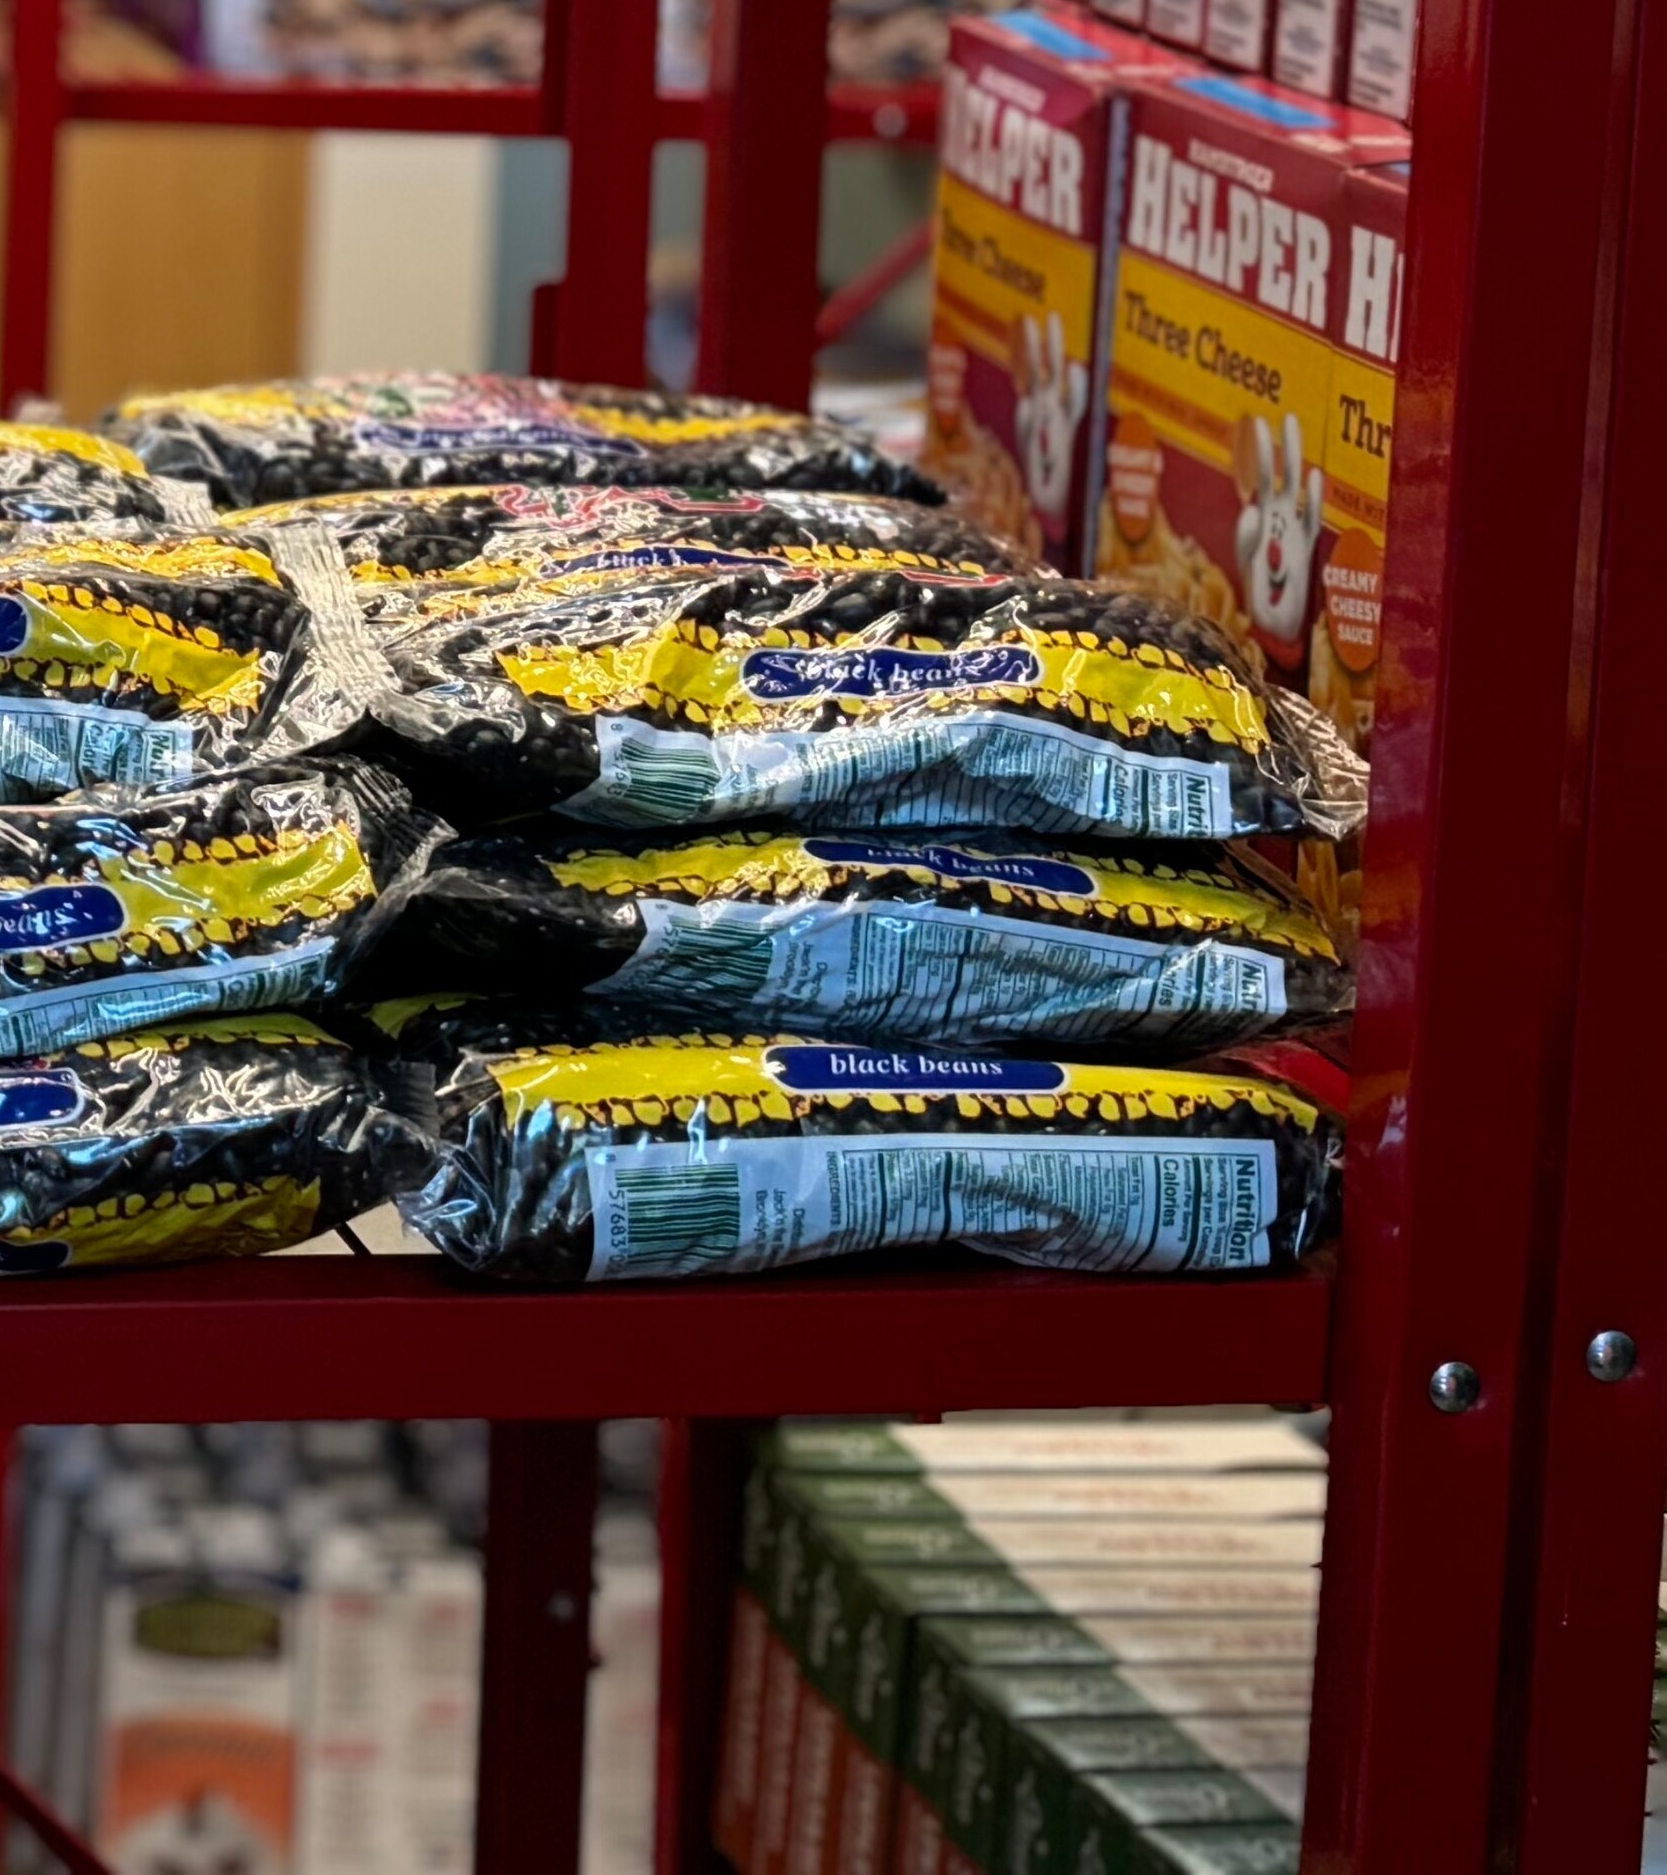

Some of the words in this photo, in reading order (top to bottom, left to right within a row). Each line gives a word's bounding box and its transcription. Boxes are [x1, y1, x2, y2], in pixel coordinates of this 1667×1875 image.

[942, 62, 1084, 237] HELPER
[1128, 133, 1330, 330] HELPER
[1124, 289, 1191, 360] Three
[1193, 328, 1282, 405] Cheese
[1339, 393, 1392, 459] Thr
[1323, 565, 1378, 594] CREAMY
[1331, 596, 1382, 624] CHEESY
[1338, 624, 1375, 647] SAUCE
[892, 662, 970, 683] bean
[829, 1053, 911, 1075] black
[918, 1054, 1004, 1076] beans
[1161, 1158, 1180, 1227] Calories
[1228, 1157, 1256, 1262] Nutrition
